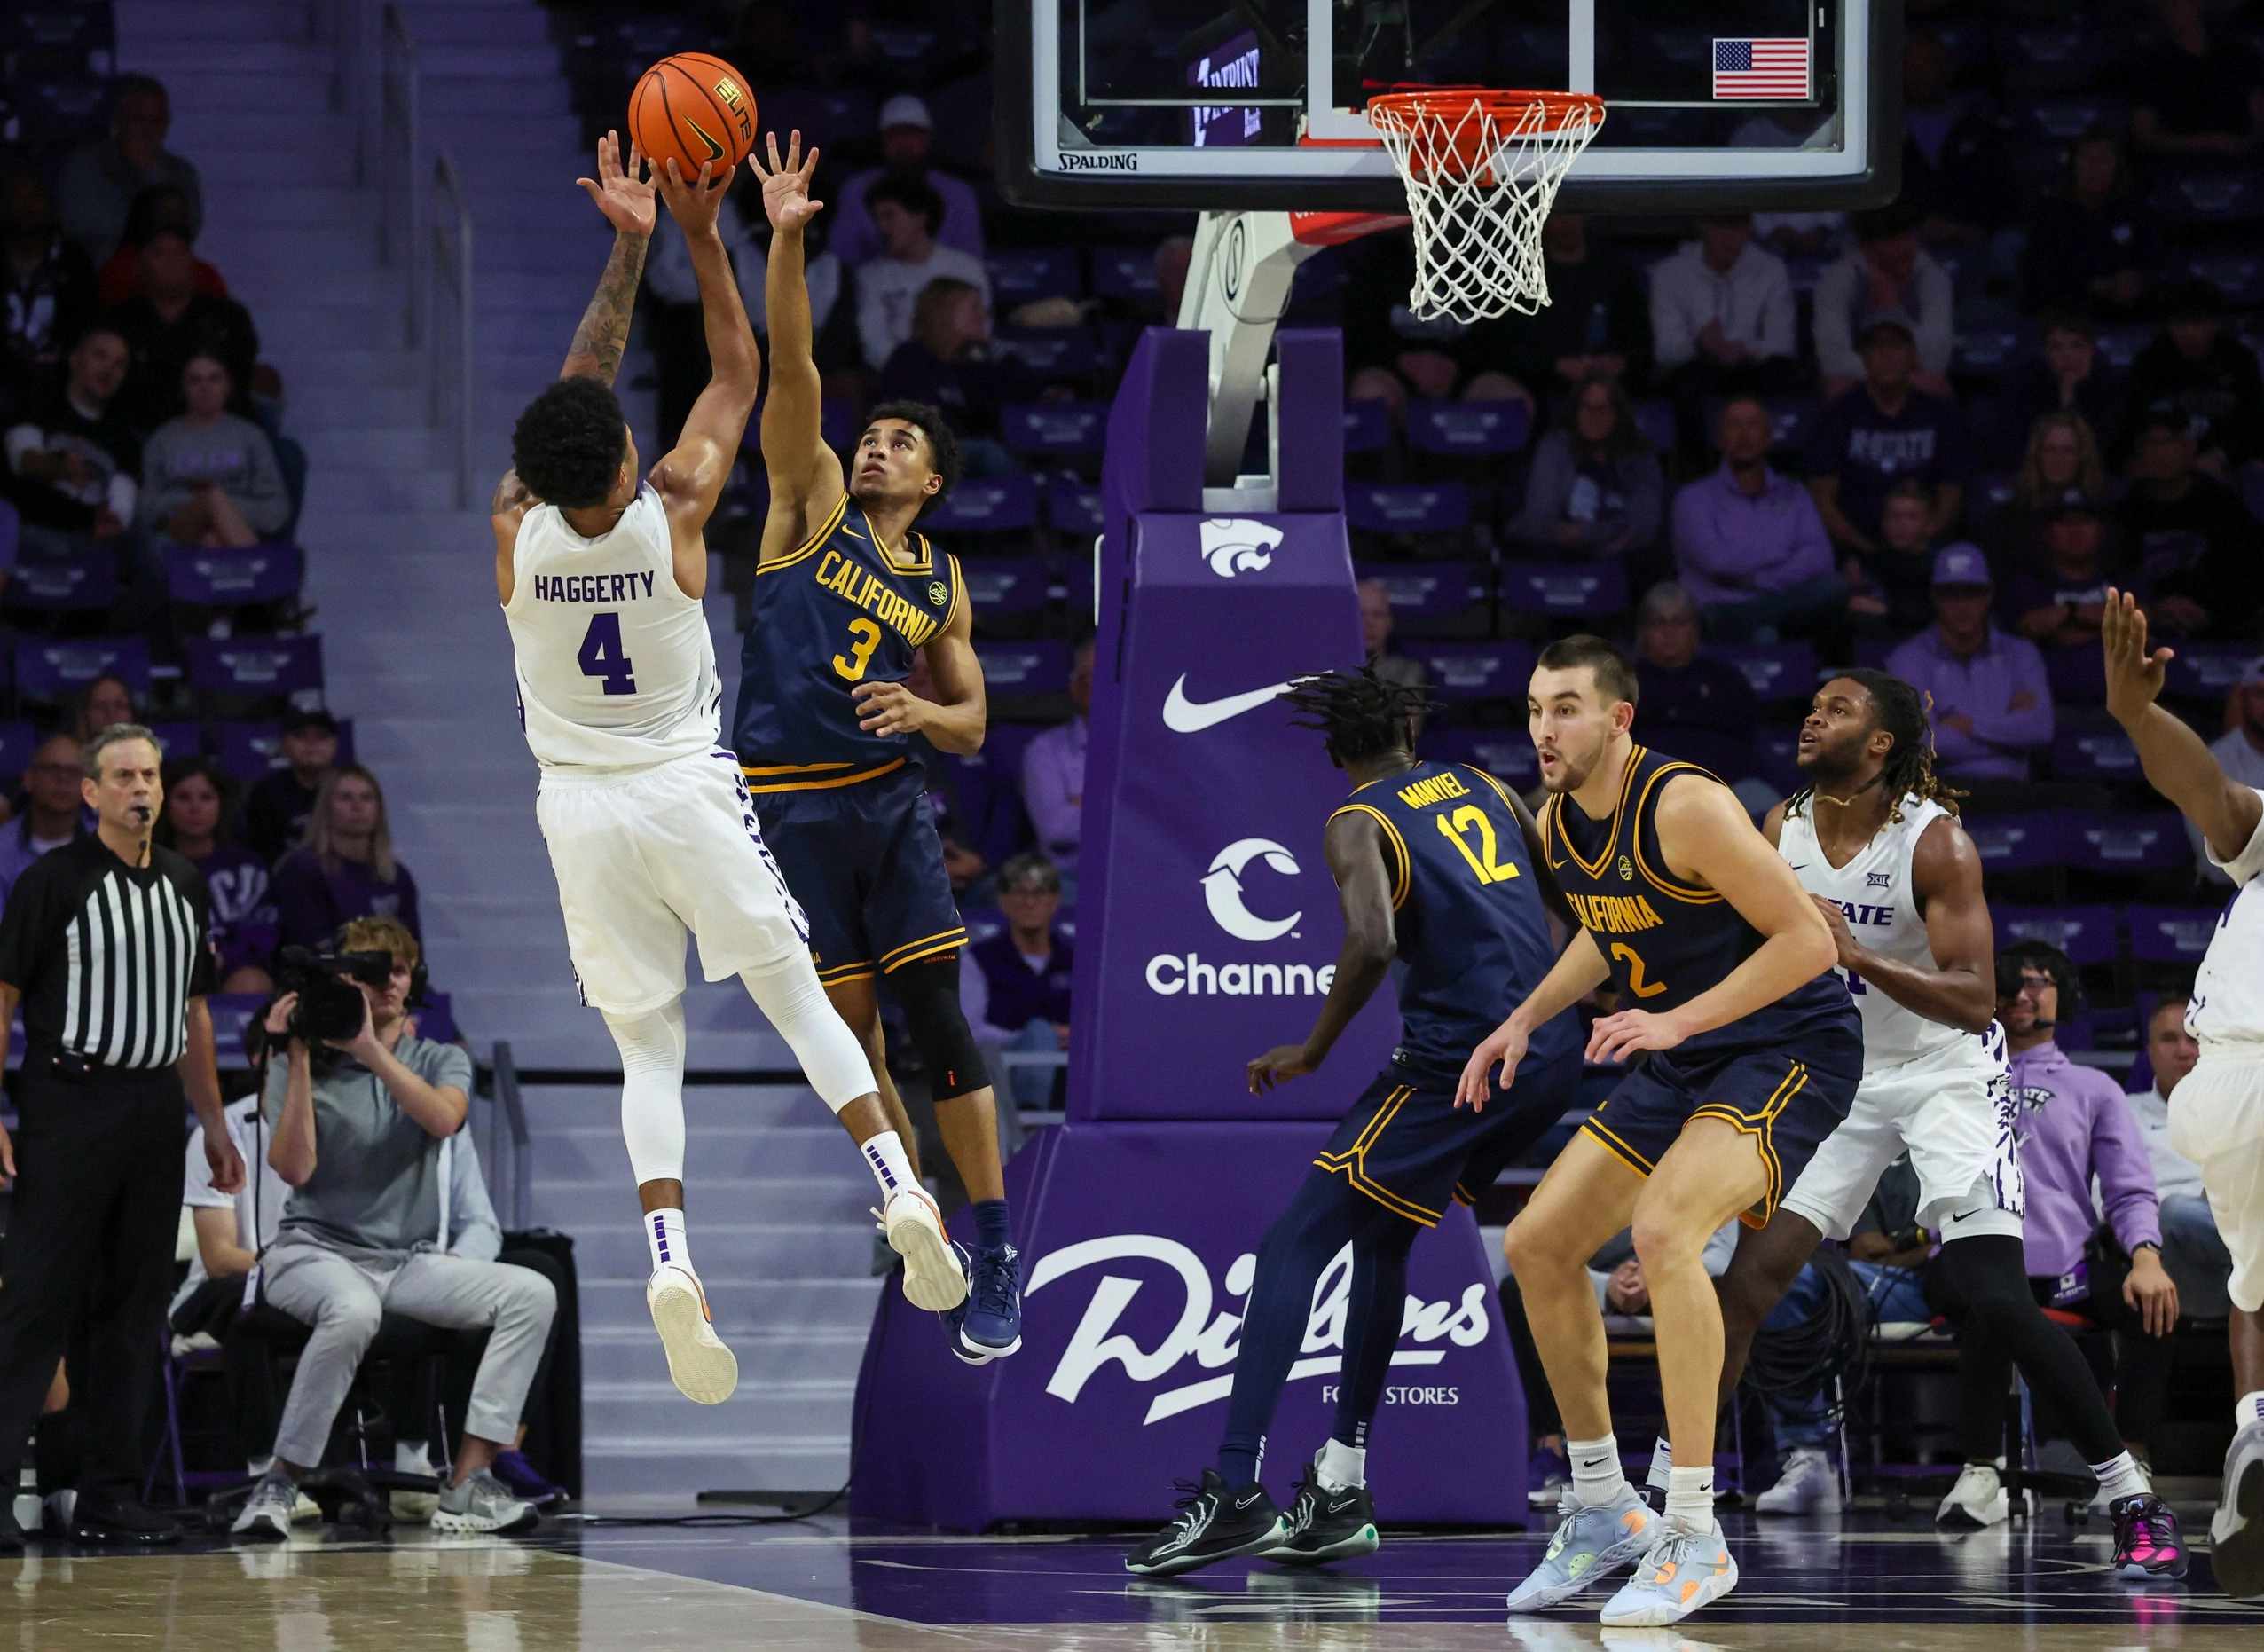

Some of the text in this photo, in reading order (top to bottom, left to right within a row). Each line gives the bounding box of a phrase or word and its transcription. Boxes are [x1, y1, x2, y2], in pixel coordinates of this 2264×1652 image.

[713, 80, 751, 144] ELITE
[1058, 153, 1137, 171] SPALDING
[534, 570, 655, 602] HAGGERTY
[577, 612, 637, 696] 4
[832, 617, 882, 681] 3
[1397, 771, 1471, 809] MANYIEL
[1436, 804, 1521, 885] 12
[1145, 952, 1337, 995] Channe
[1610, 942, 1668, 998] 2
[1385, 1386, 1459, 1405] STORES
